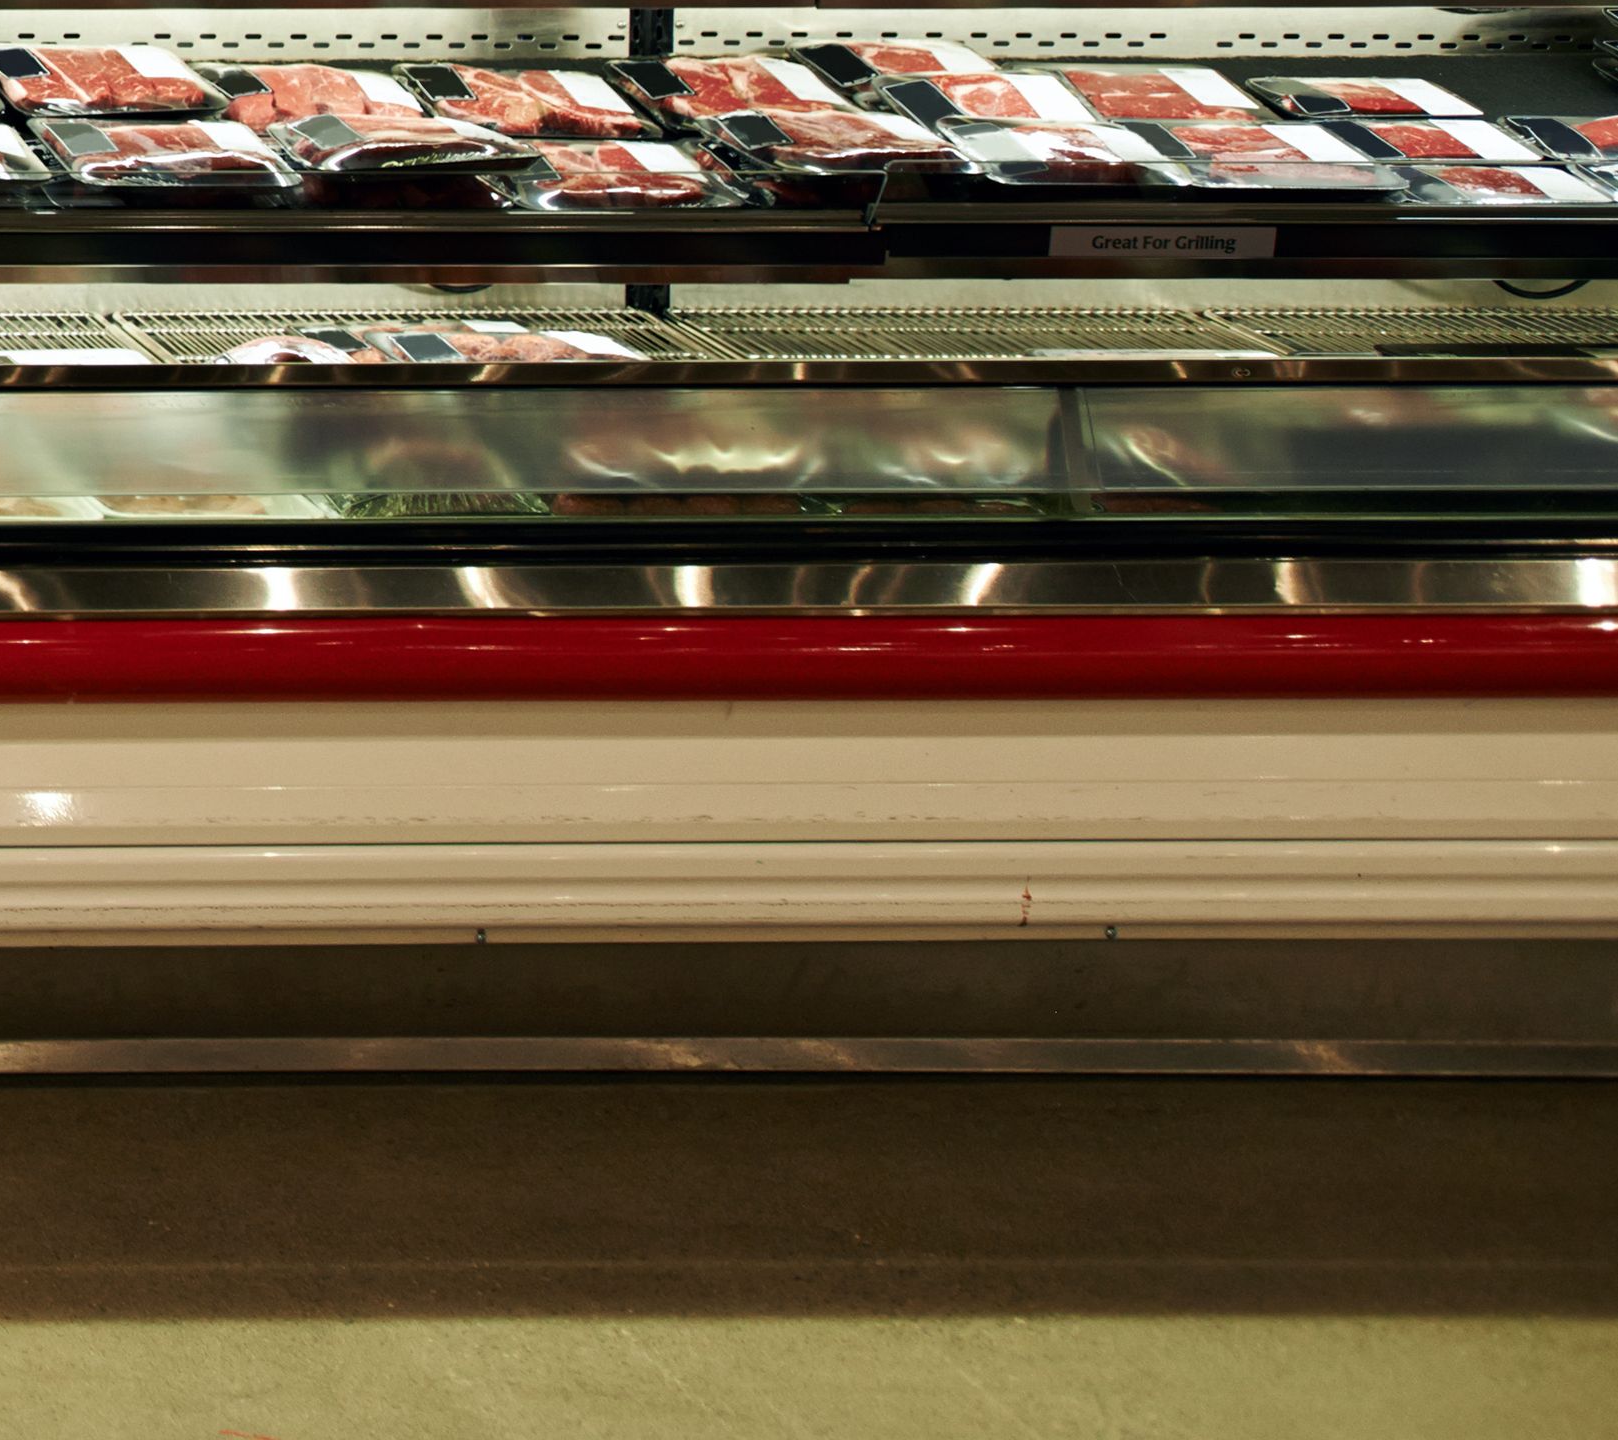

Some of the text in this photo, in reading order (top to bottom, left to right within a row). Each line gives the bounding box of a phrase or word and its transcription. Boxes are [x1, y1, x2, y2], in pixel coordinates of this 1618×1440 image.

[1092, 236, 1237, 254] Great For Grilling
